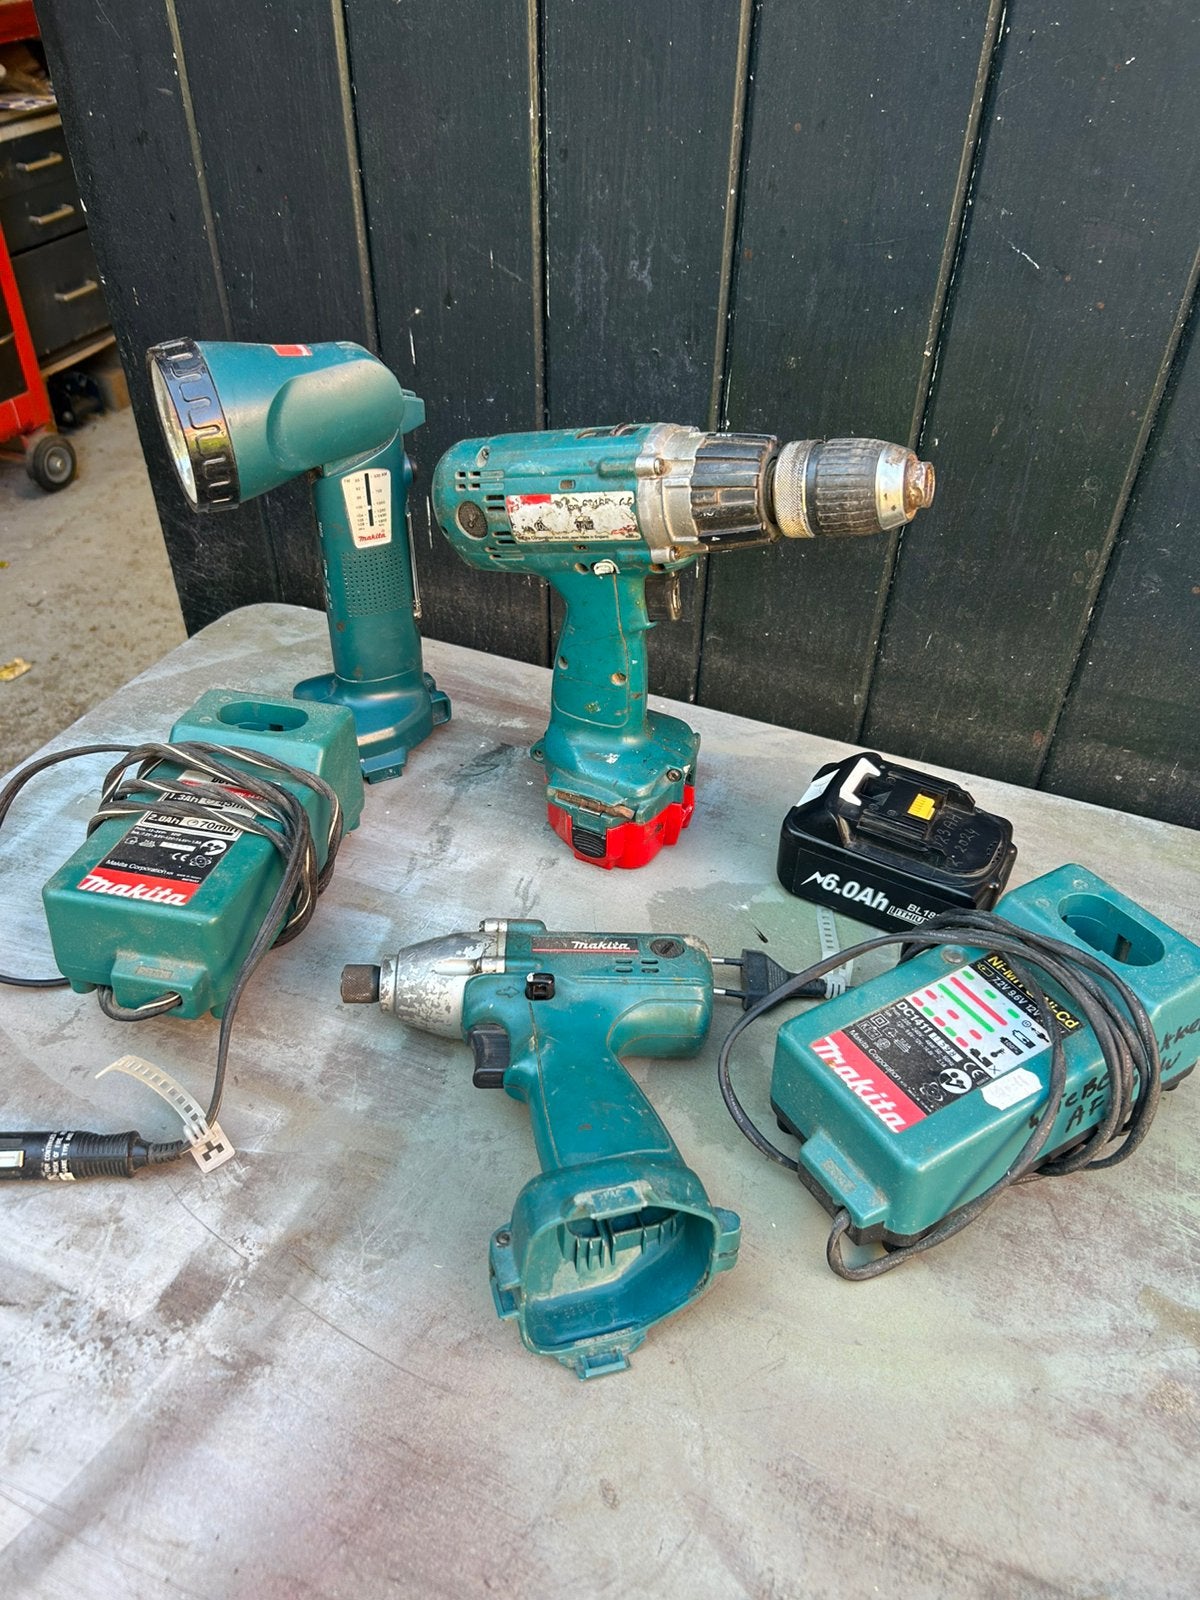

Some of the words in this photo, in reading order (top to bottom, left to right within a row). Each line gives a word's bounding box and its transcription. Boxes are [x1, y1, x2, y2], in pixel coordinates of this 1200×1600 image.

[358, 533, 386, 541] makita
[168, 792, 199, 806] 1.3Ah
[147, 814, 180, 825] 2.0Ah
[105, 859, 130, 869] Makita
[128, 863, 168, 876] Corporation
[77, 875, 188, 906] makita
[822, 873, 889, 912] 6.0Ah
[907, 904, 941, 920] BL18
[571, 940, 630, 950] makita
[896, 1001, 933, 1034] DC1411
[849, 1030, 869, 1050] Makita
[868, 1048, 902, 1081] Corporation
[811, 1036, 907, 1133] makita
